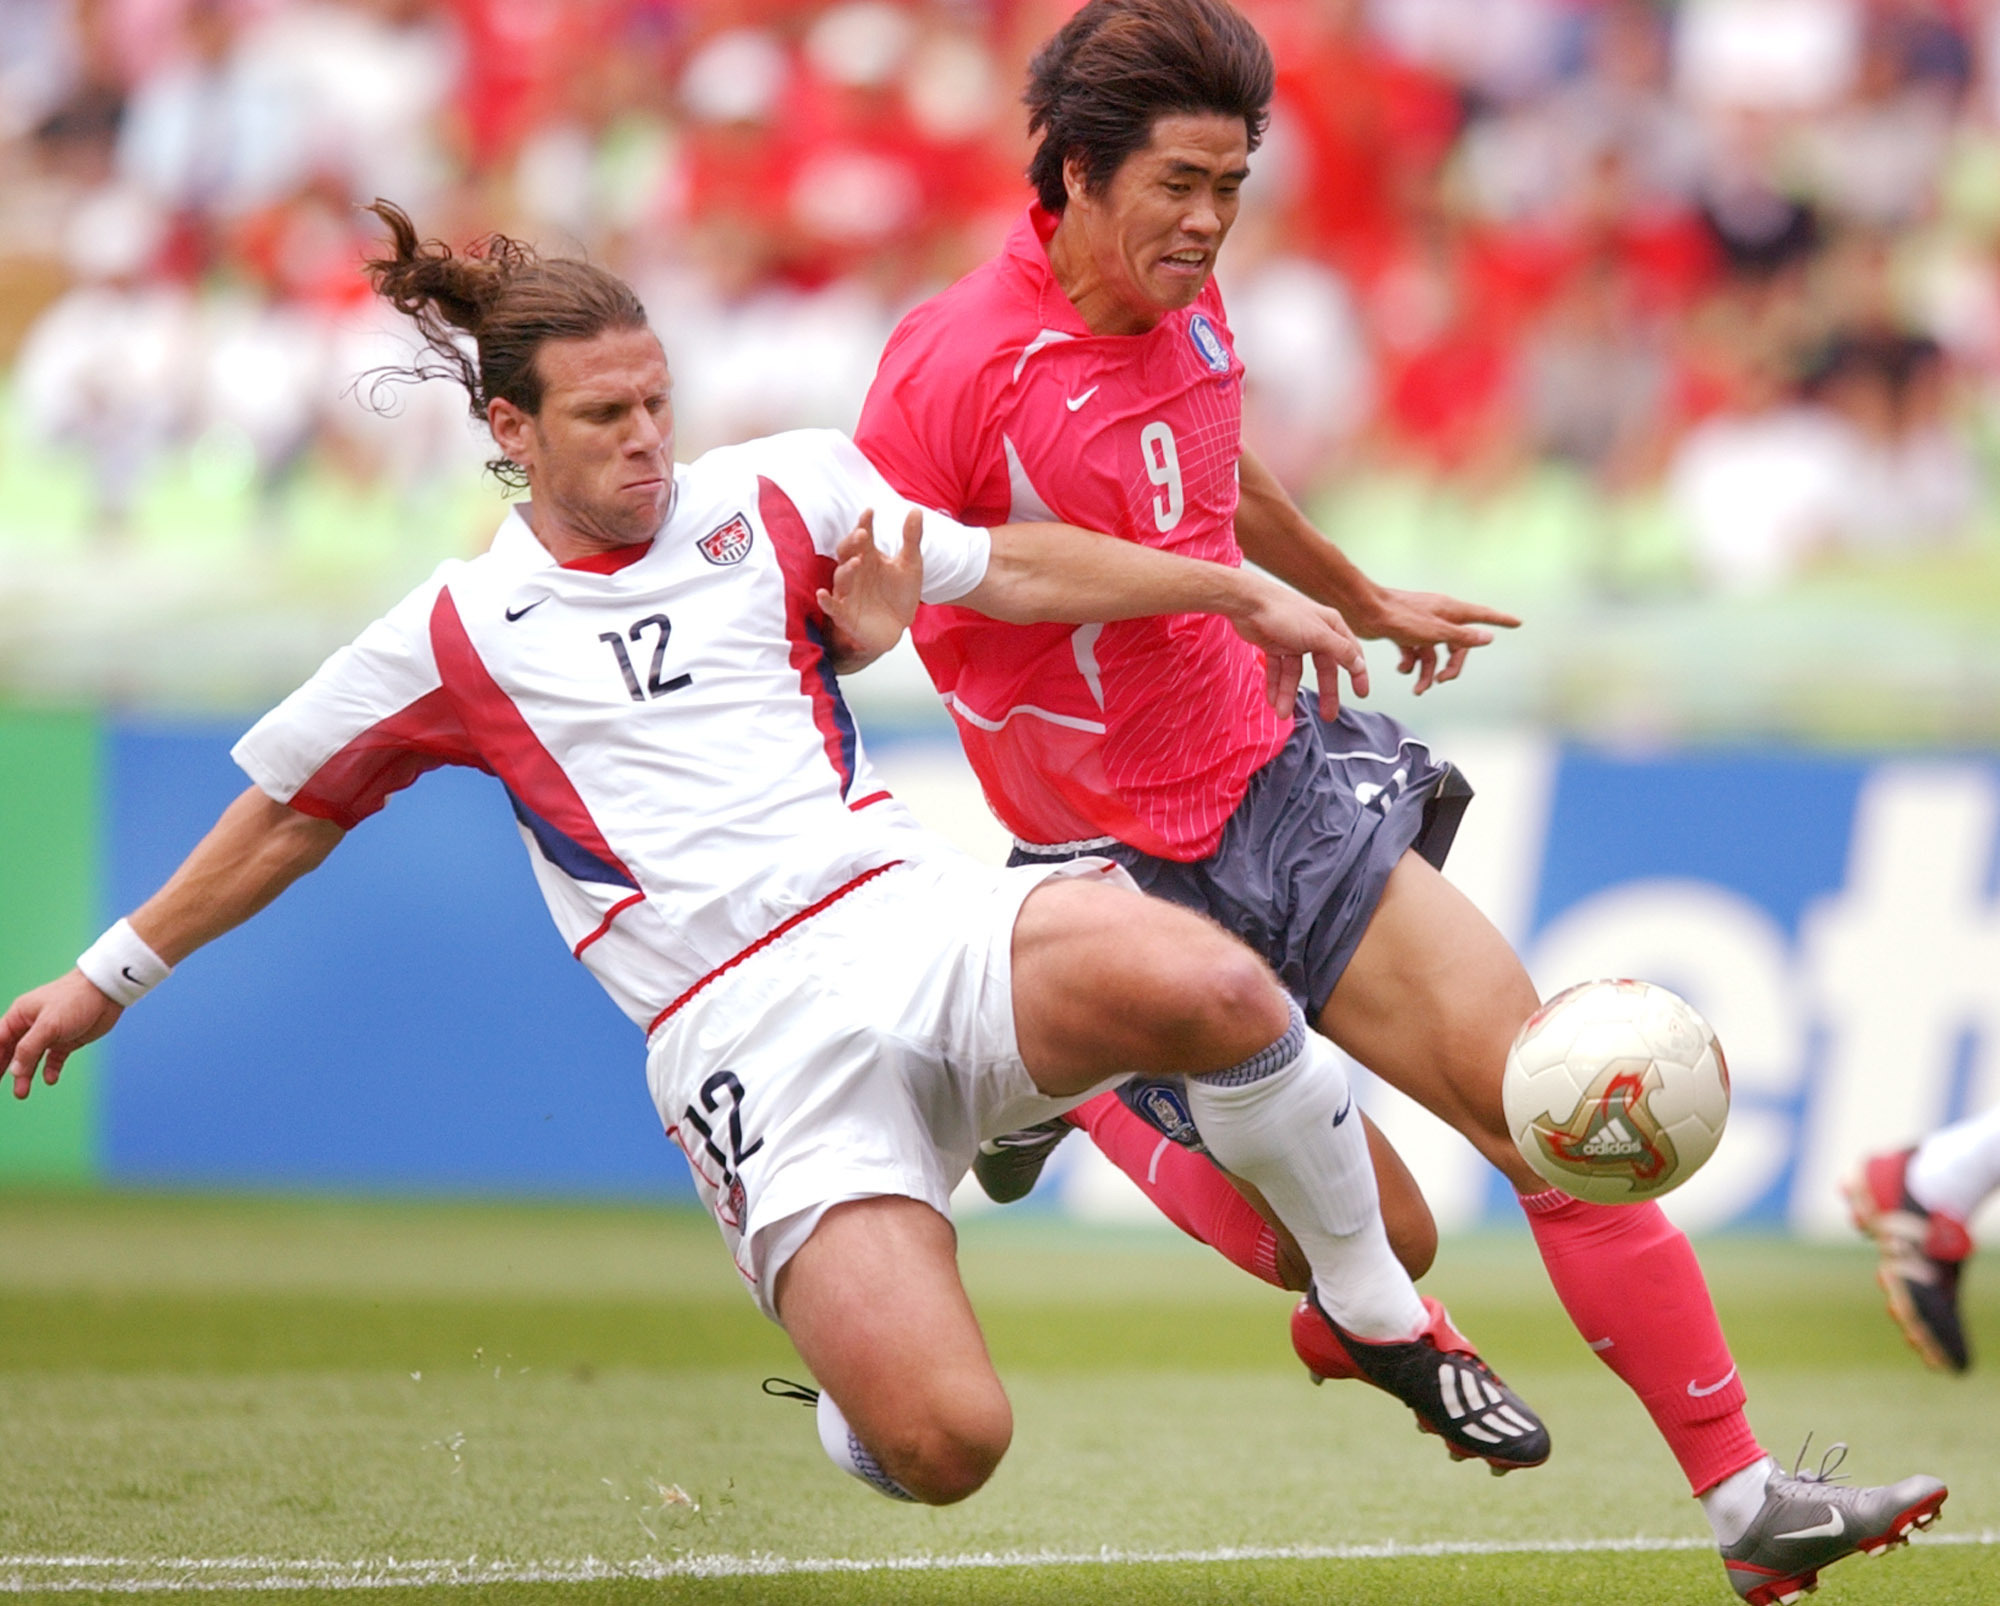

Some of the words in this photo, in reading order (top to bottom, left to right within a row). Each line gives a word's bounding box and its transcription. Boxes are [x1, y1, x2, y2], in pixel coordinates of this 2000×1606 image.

[1140, 421, 1184, 533] 9
[598, 613, 693, 702] 12
[683, 1070, 765, 1186] 12
